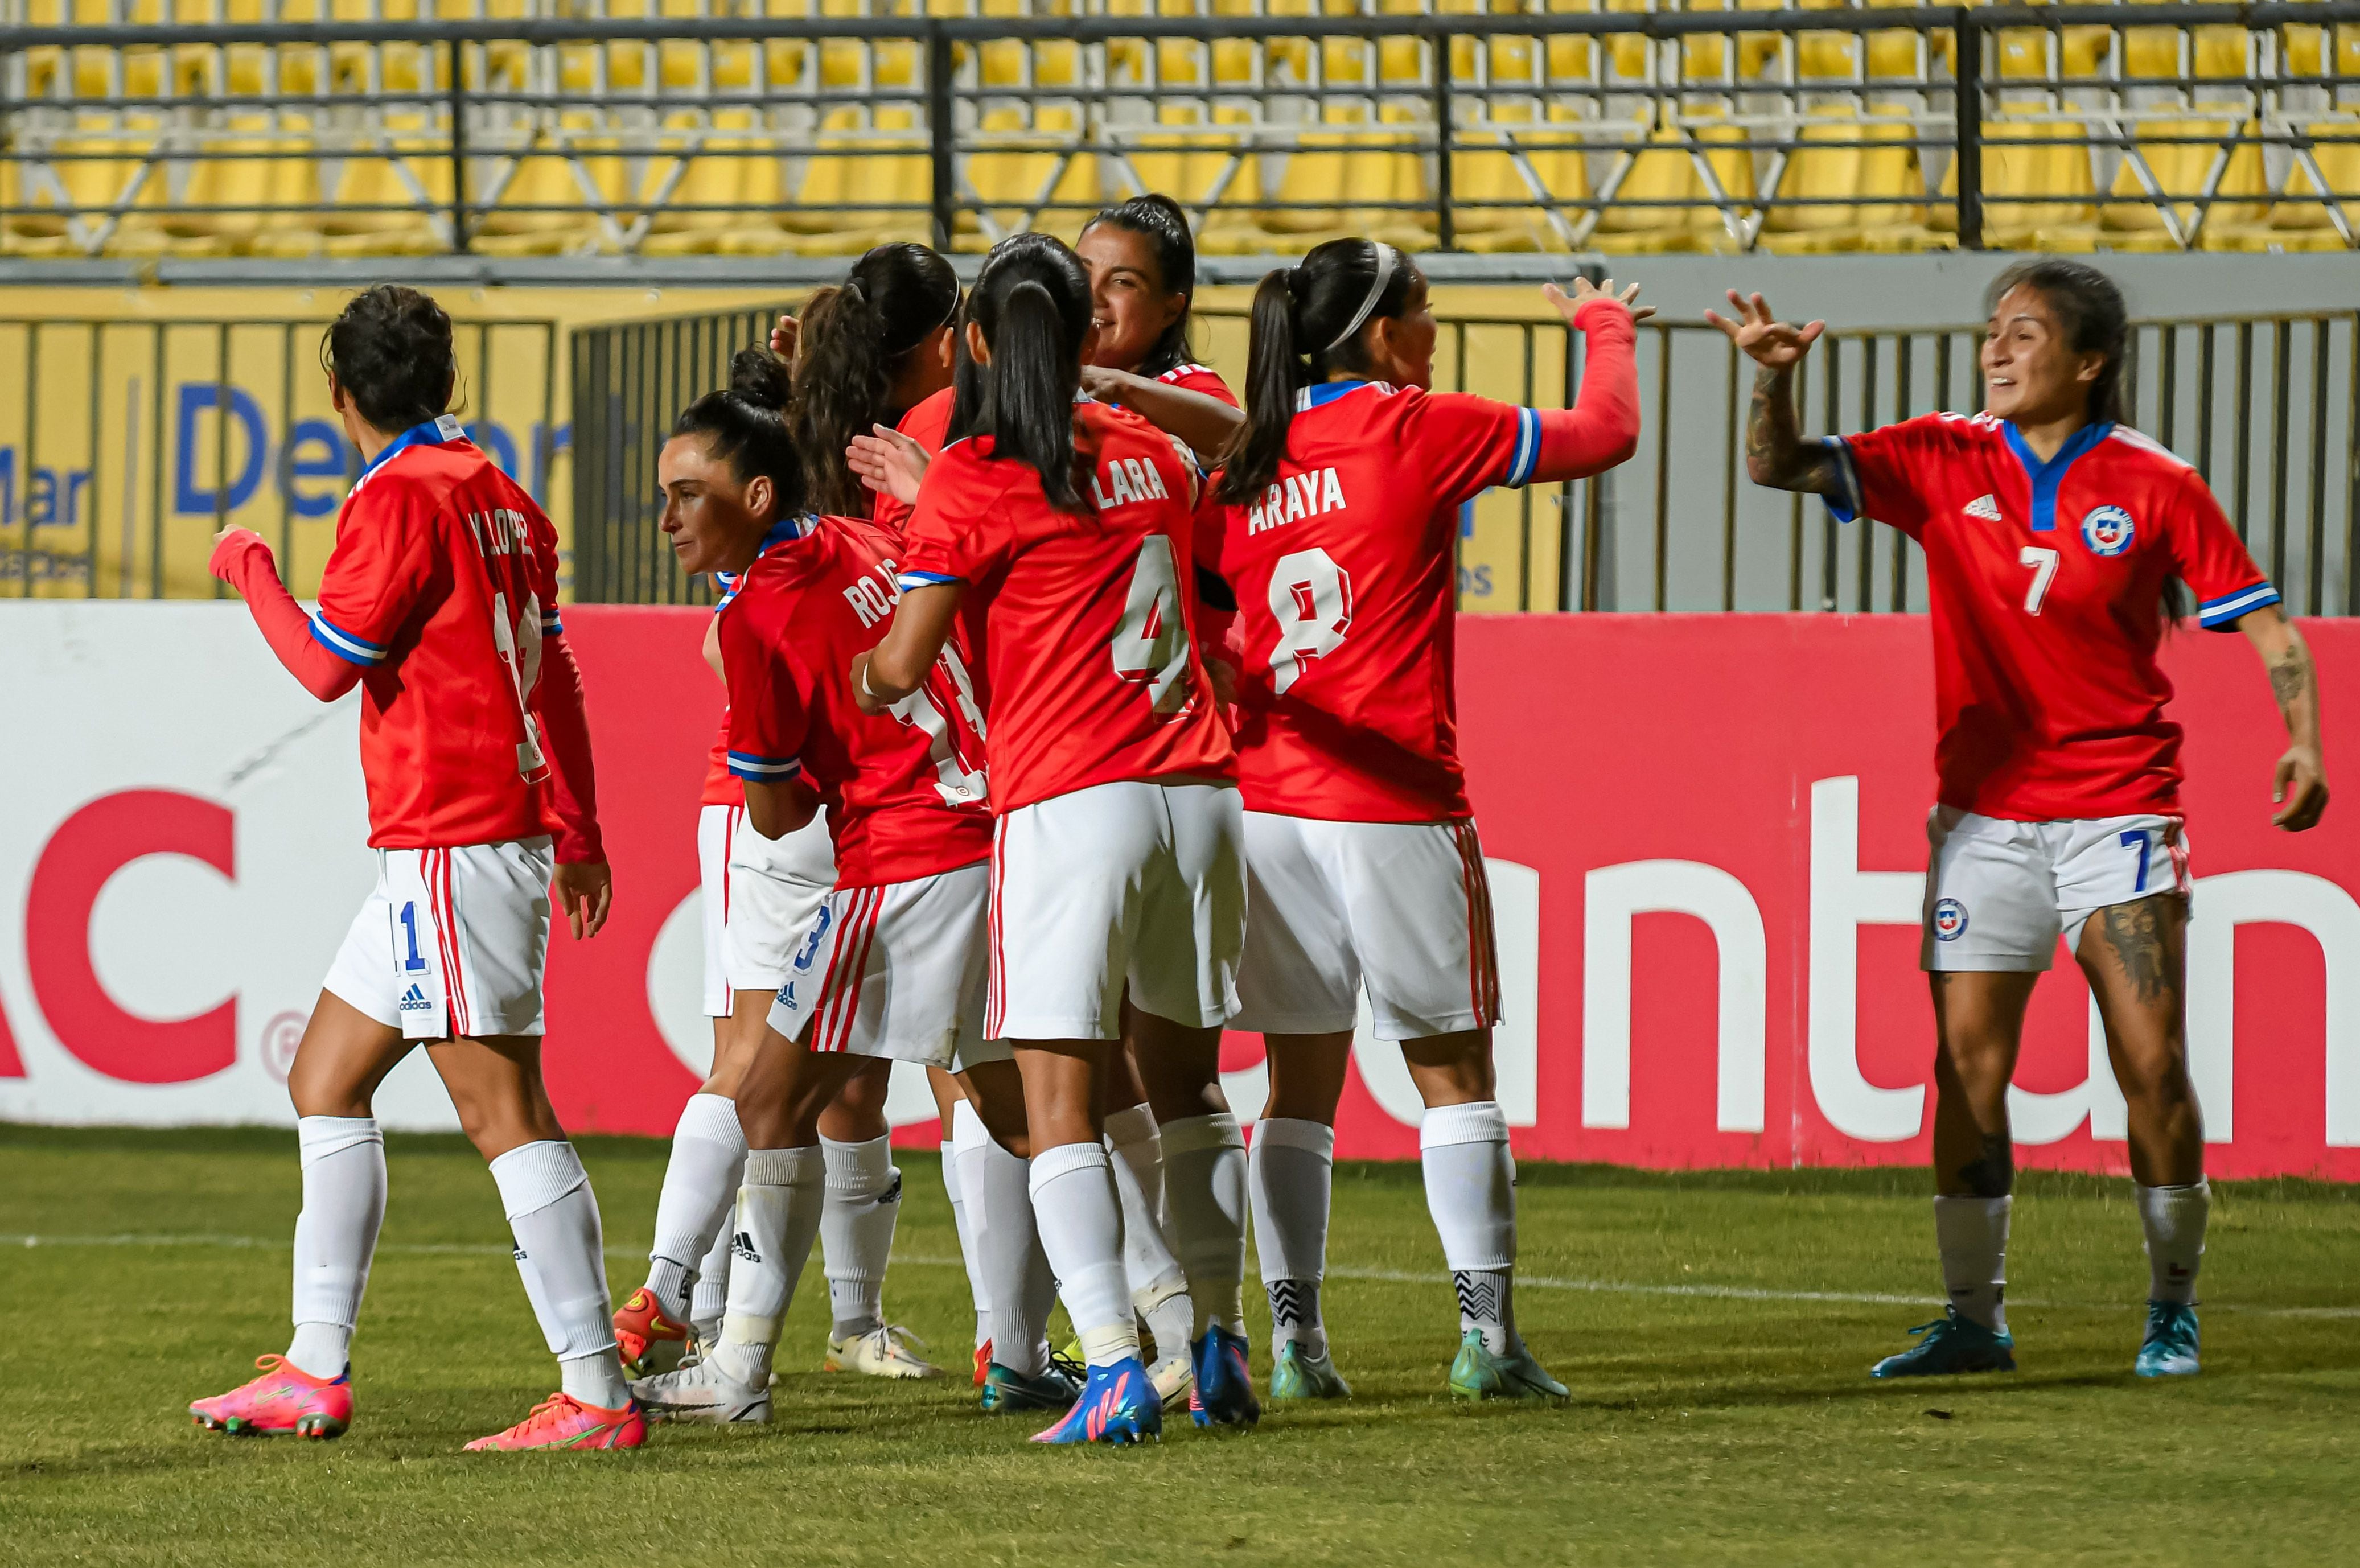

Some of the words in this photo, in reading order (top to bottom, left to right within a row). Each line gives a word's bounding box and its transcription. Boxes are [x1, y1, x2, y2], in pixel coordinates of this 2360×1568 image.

[0, 446, 94, 525] ar
[1092, 457, 1170, 509] LARA
[1249, 467, 1347, 536] ARAYA
[468, 512, 485, 558] Y
[2020, 546, 2059, 617] 7
[1111, 534, 1195, 725] 4
[1268, 546, 1352, 696] 8
[2119, 829, 2152, 893] 7
[0, 787, 238, 1085] C
[399, 999, 432, 1011] adidas
